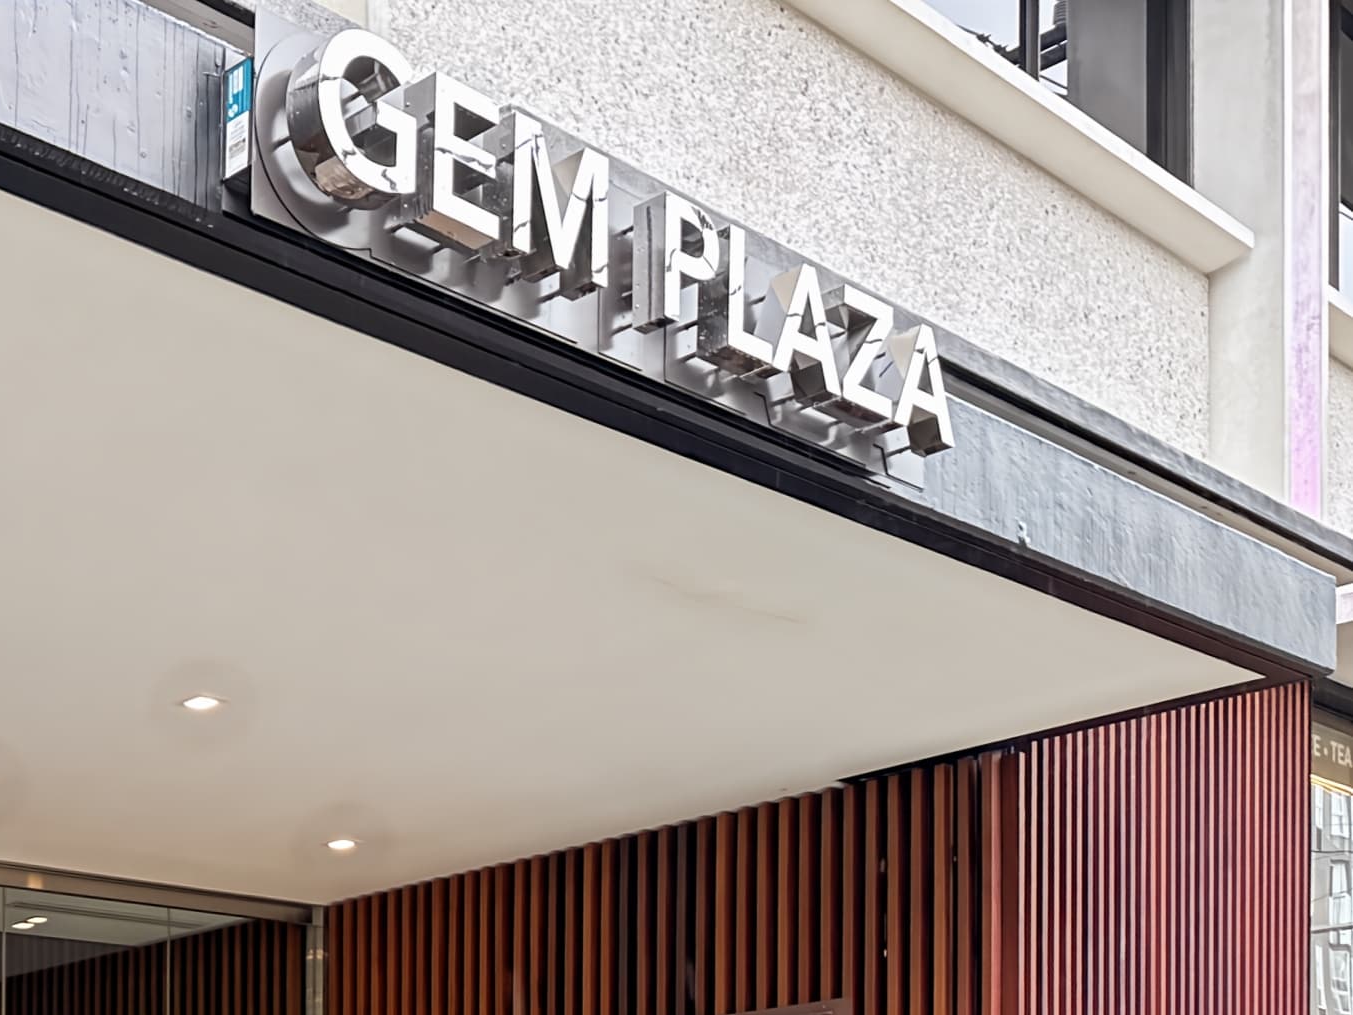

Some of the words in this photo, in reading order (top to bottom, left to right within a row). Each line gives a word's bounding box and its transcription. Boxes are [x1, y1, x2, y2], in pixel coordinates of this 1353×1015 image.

[315, 28, 610, 289] GEM
[663, 190, 955, 449] PLAZA
[1330, 740, 1353, 768] TEA
